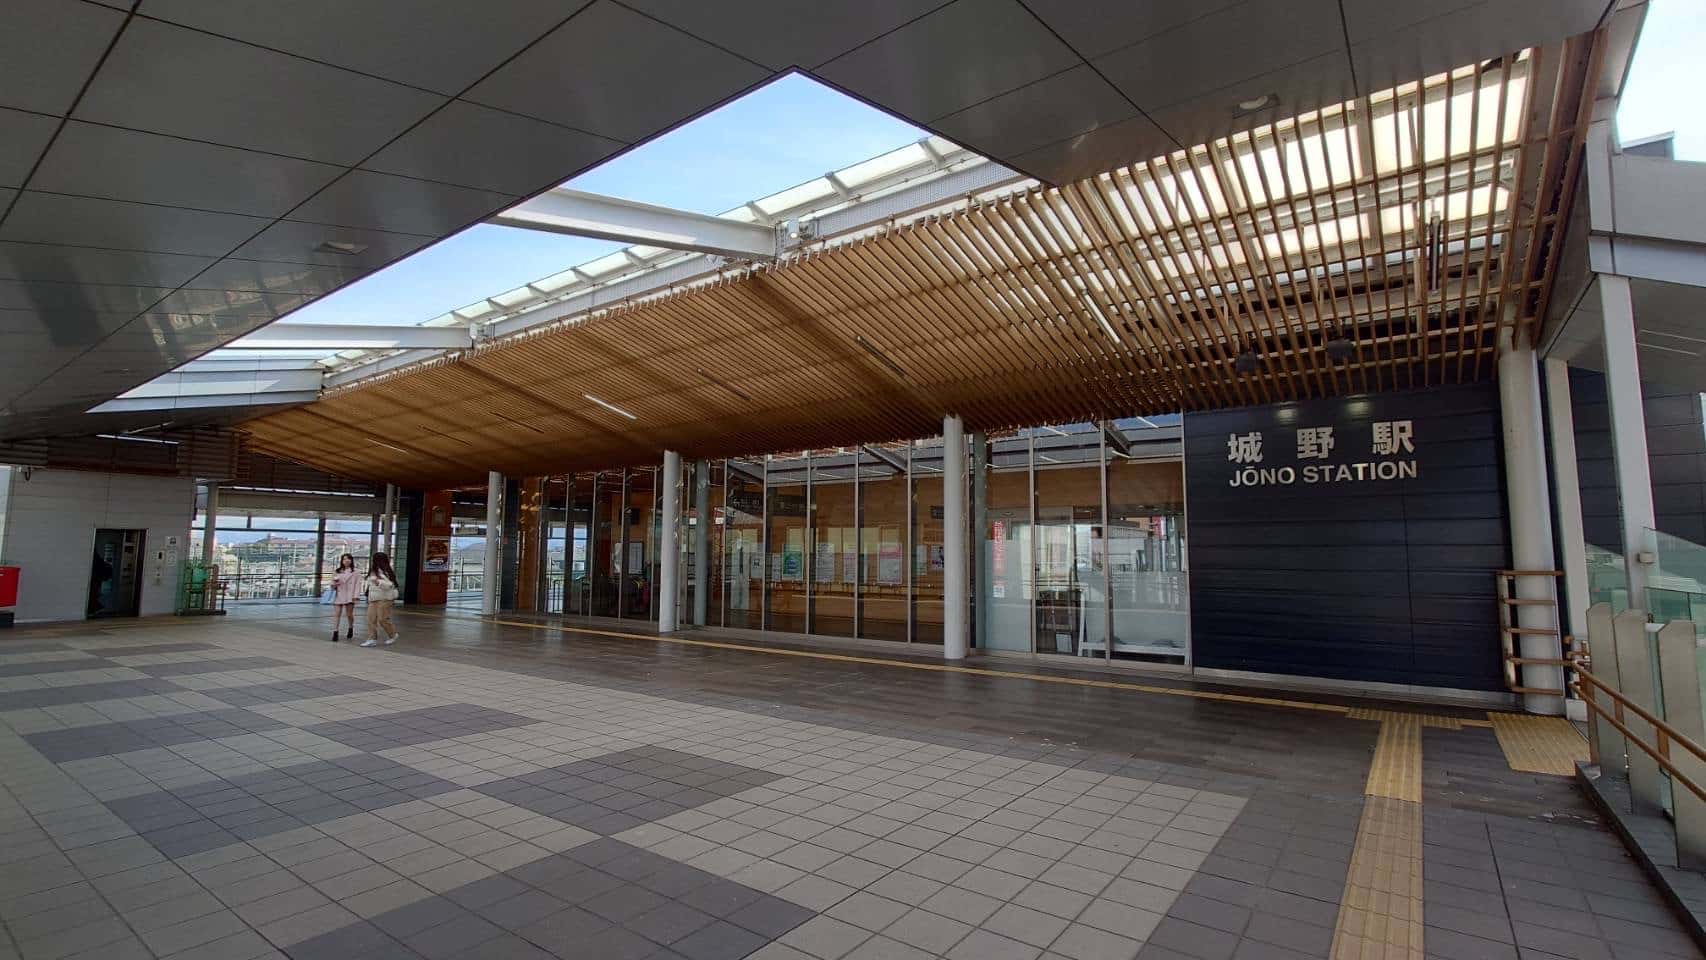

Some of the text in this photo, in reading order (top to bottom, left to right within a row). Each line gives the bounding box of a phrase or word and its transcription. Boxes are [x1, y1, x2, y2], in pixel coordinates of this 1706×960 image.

[1228, 420, 1415, 464] 城野駅
[1229, 460, 1417, 487] JŌNO STATION
